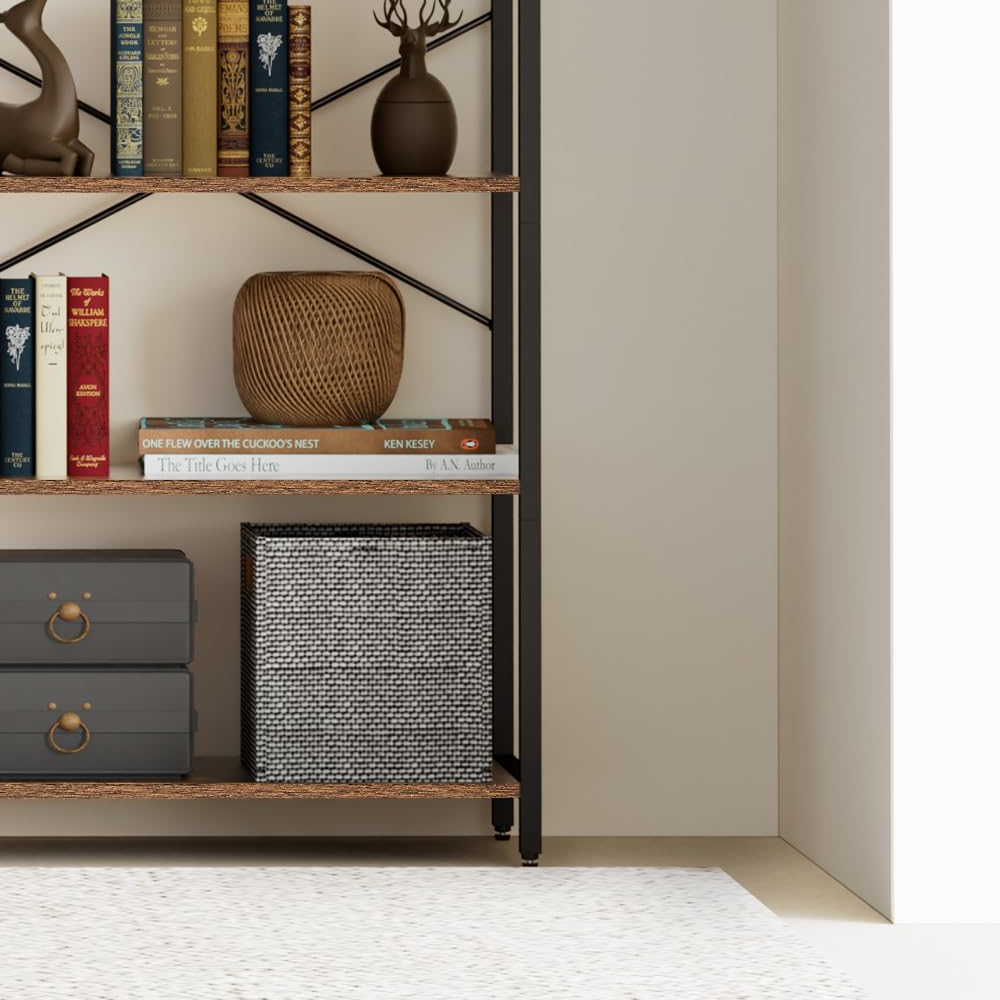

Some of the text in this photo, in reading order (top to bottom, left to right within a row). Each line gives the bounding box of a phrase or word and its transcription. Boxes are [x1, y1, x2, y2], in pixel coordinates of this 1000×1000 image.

[70, 288, 82, 296] The
[83, 288, 104, 296] Works
[83, 298, 91, 307] of
[72, 308, 104, 316] WILLIAM
[142, 439, 319, 449] ONE FLEW OVER THE CUCKOO'S NEST
[384, 439, 435, 449] KEN KESEY
[157, 458, 280, 472] The Title Goes Here
[426, 459, 437, 472] By
[464, 459, 495, 471] Author
